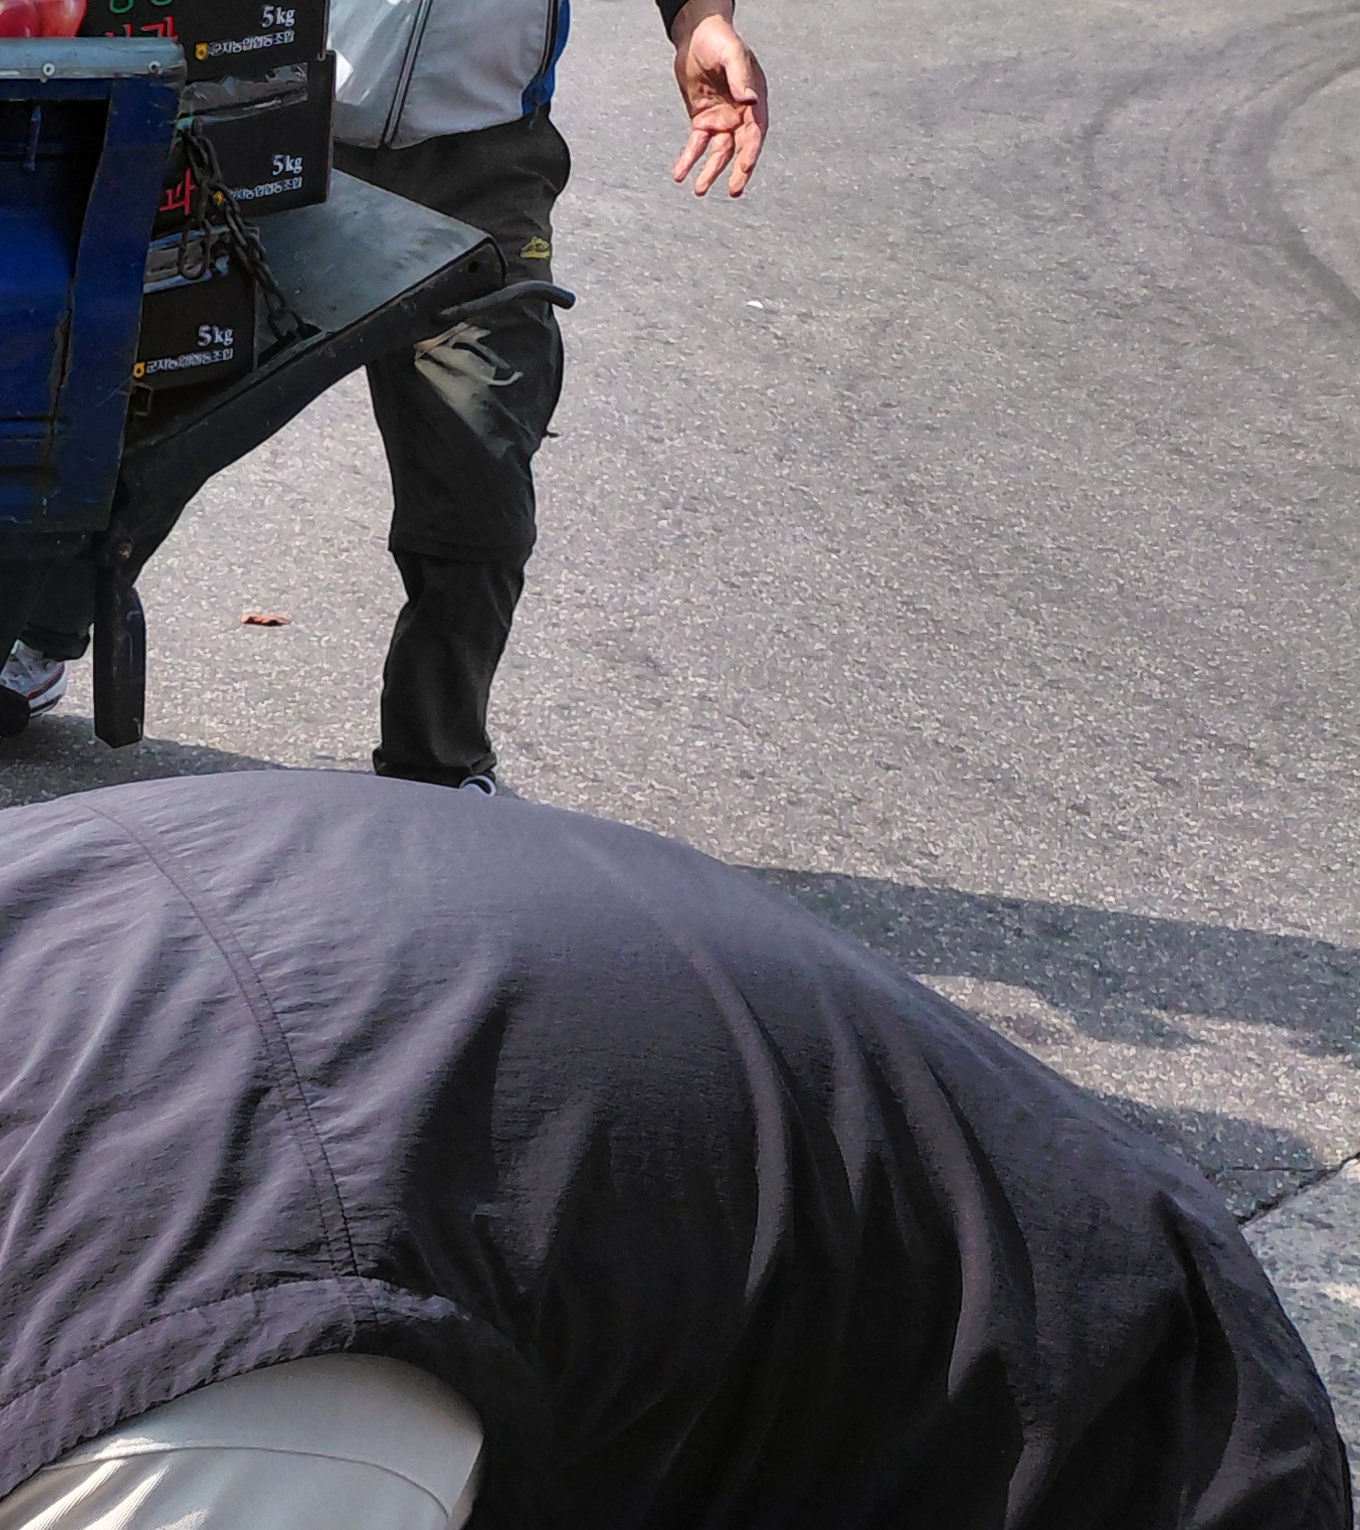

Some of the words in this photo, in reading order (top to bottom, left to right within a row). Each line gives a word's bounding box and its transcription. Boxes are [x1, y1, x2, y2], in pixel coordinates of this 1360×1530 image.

[260, 4, 296, 28] 5kg
[272, 154, 303, 176] 5kg
[197, 323, 234, 347] 5kg
